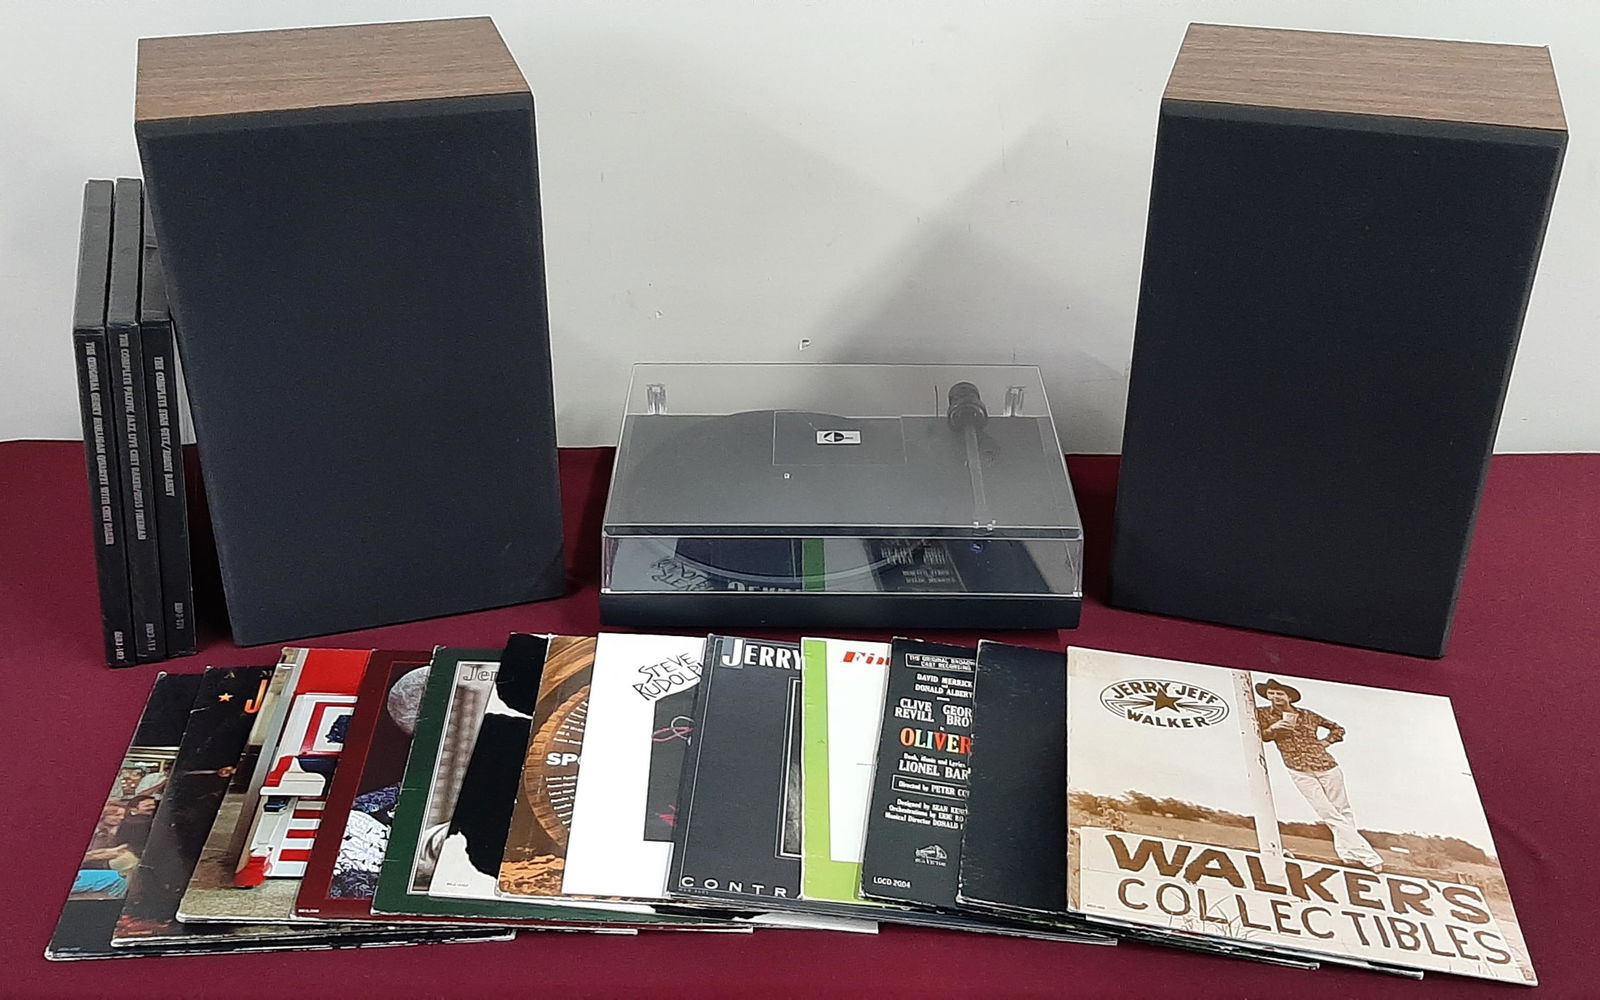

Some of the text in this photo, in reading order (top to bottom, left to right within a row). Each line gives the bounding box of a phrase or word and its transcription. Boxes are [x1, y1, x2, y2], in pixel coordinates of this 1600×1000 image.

[120, 348, 132, 384] COMPLETE
[126, 414, 136, 432] JAZZ
[128, 433, 138, 448] LIVE
[722, 639, 801, 670] JERRY
[638, 653, 698, 684] STEVE
[632, 662, 703, 701] RUDOLP
[915, 684, 944, 694] DONALD
[916, 673, 973, 688] DAVID MERRICK
[1111, 680, 1219, 705] JERRY JEFF
[900, 698, 932, 712] CLIVE
[943, 704, 972, 717] GEOR
[894, 707, 934, 722] REVILL
[946, 715, 972, 727] BRO
[1127, 709, 1210, 729] WALKER
[900, 728, 972, 754] OLIVER
[899, 759, 940, 776] LIONEL
[898, 780, 920, 790] Directed
[922, 784, 929, 792] by
[931, 784, 955, 795] PETER
[897, 799, 922, 809] Designed
[923, 802, 930, 811] by
[929, 809, 936, 819] by
[884, 811, 907, 822] Musical
[907, 815, 931, 825] Director
[932, 818, 959, 829] DONALD
[681, 876, 802, 899] CONTR
[1105, 834, 1490, 924] WALKER'S
[1118, 878, 1511, 965] COLLECTIBLES
